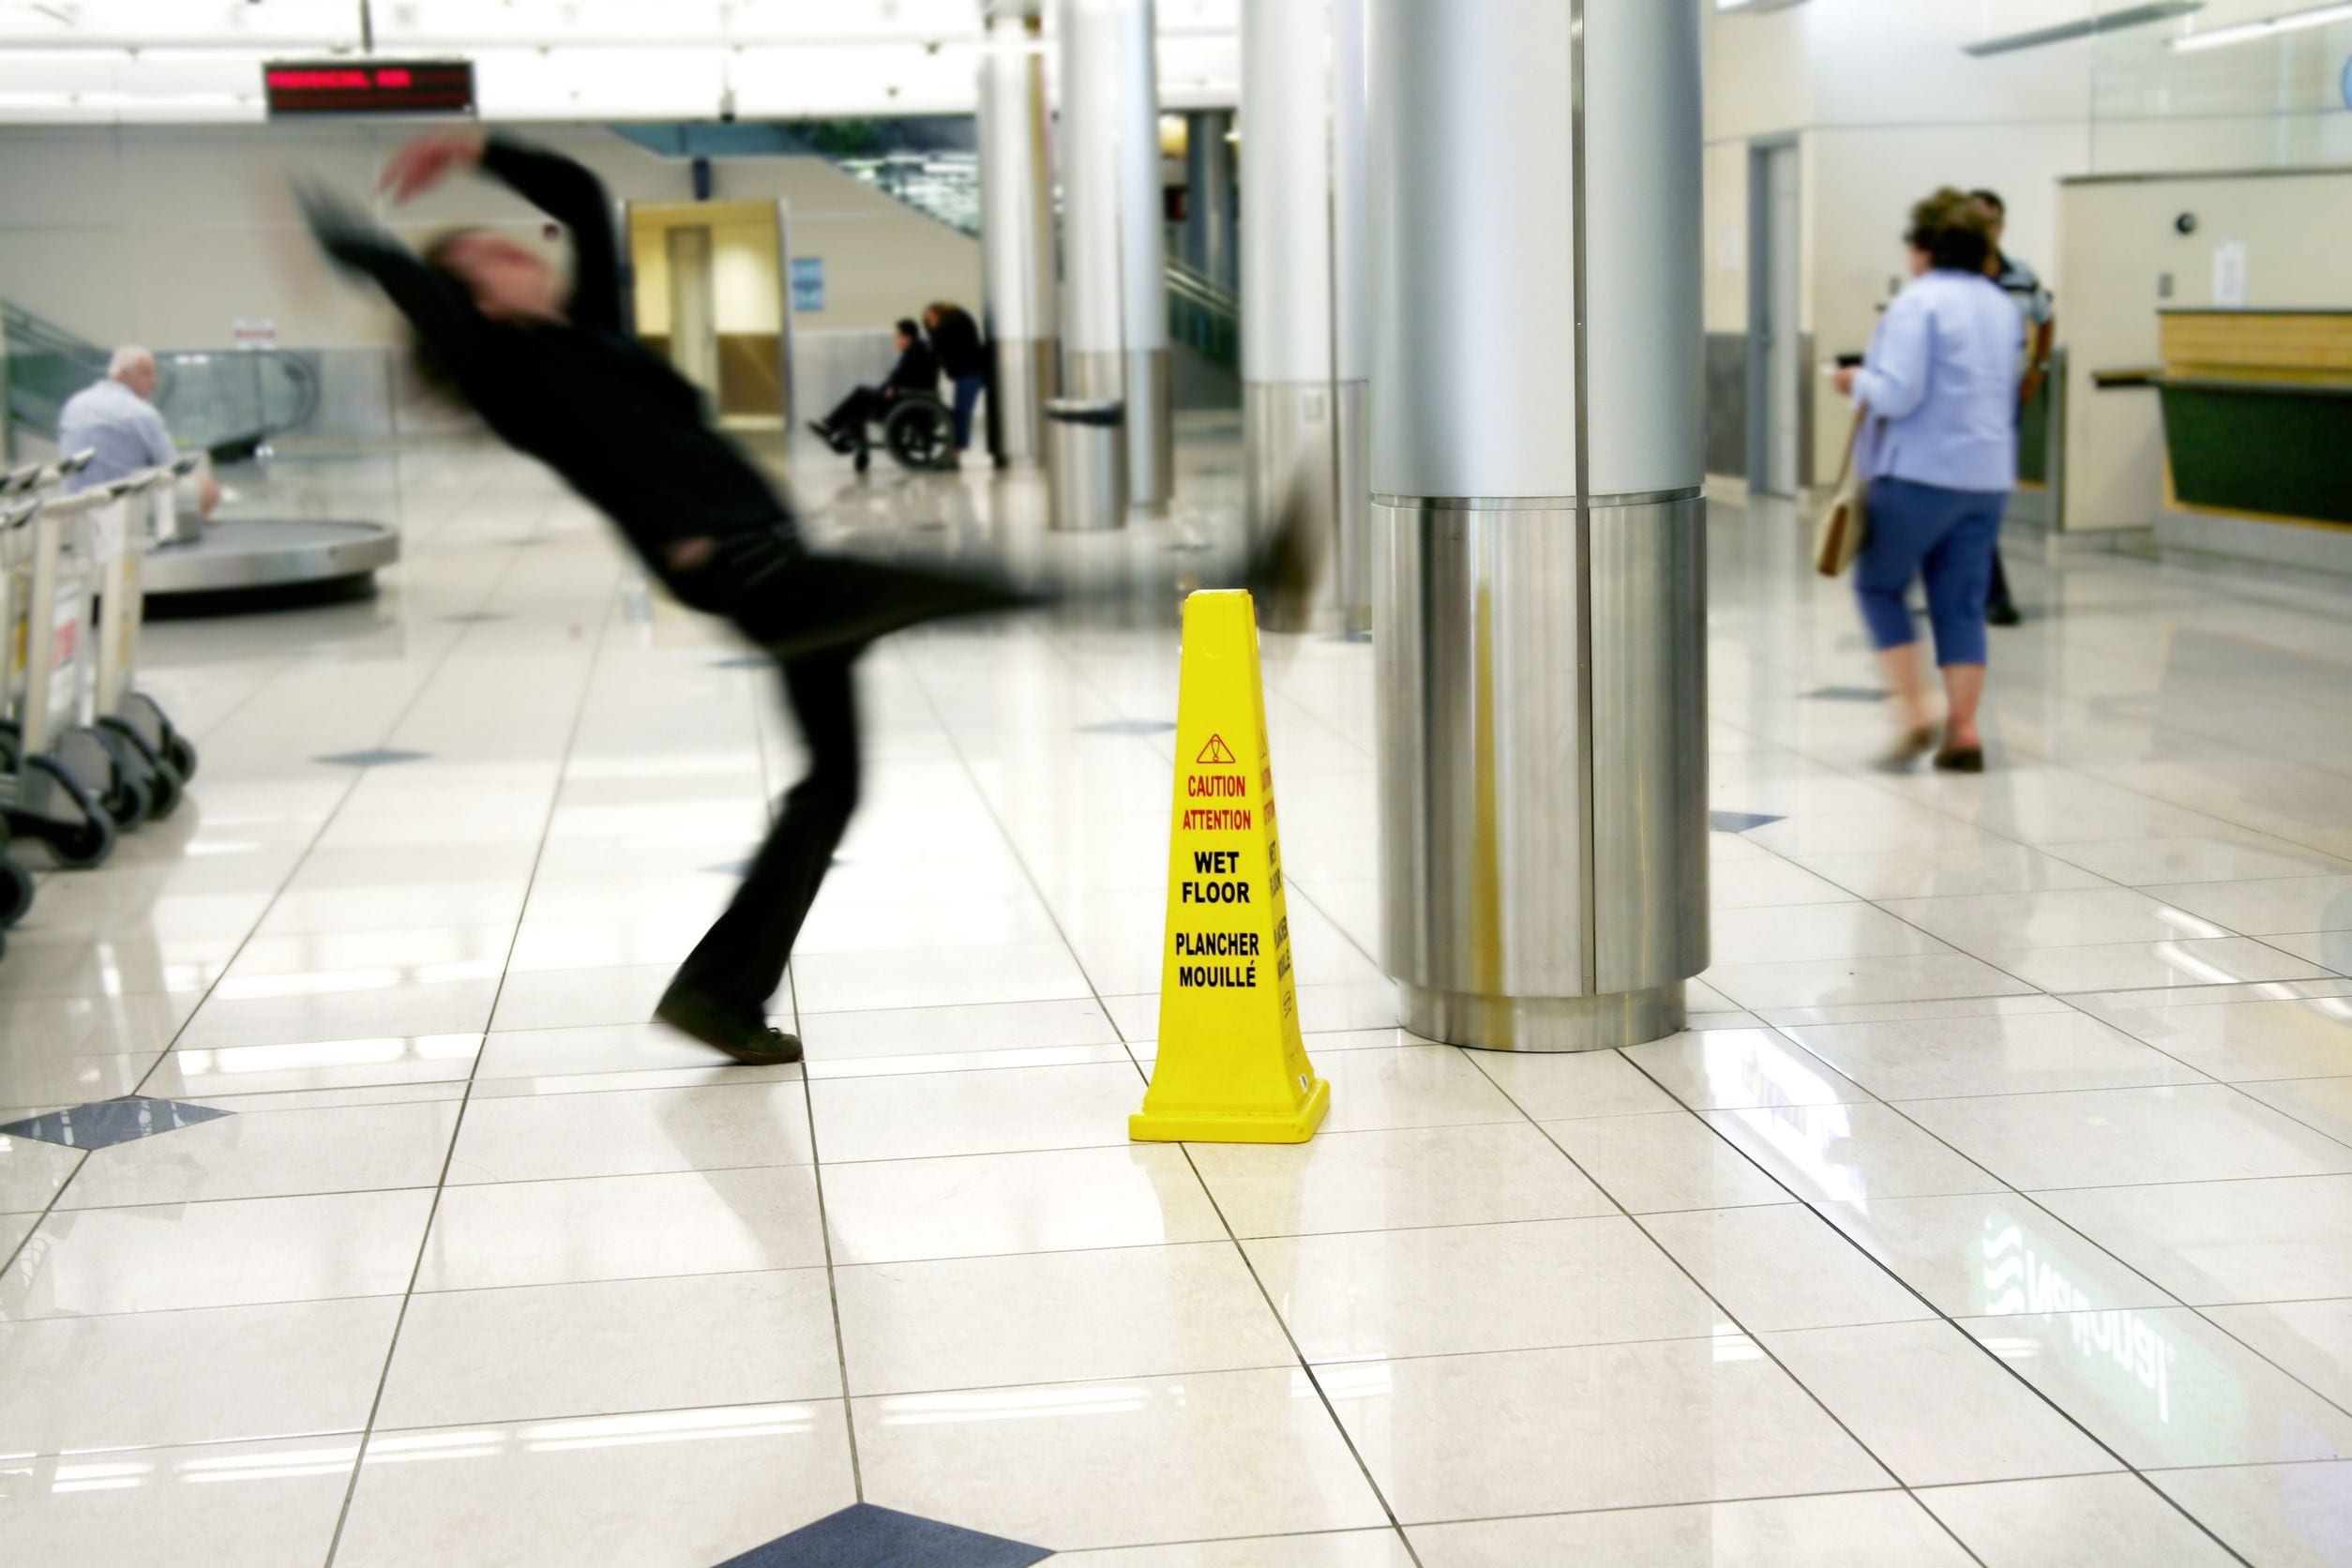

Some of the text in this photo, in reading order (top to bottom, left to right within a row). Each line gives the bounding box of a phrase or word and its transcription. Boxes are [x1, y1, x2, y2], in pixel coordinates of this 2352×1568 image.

[1187, 775, 1246, 797] CAUTION
[1183, 809, 1251, 831] ATTENTION
[1194, 851, 1240, 874] WET
[1182, 882, 1251, 904] FLOOR
[1175, 932, 1259, 957] PLANCHER
[1179, 959, 1257, 988] MOUILLÉ
